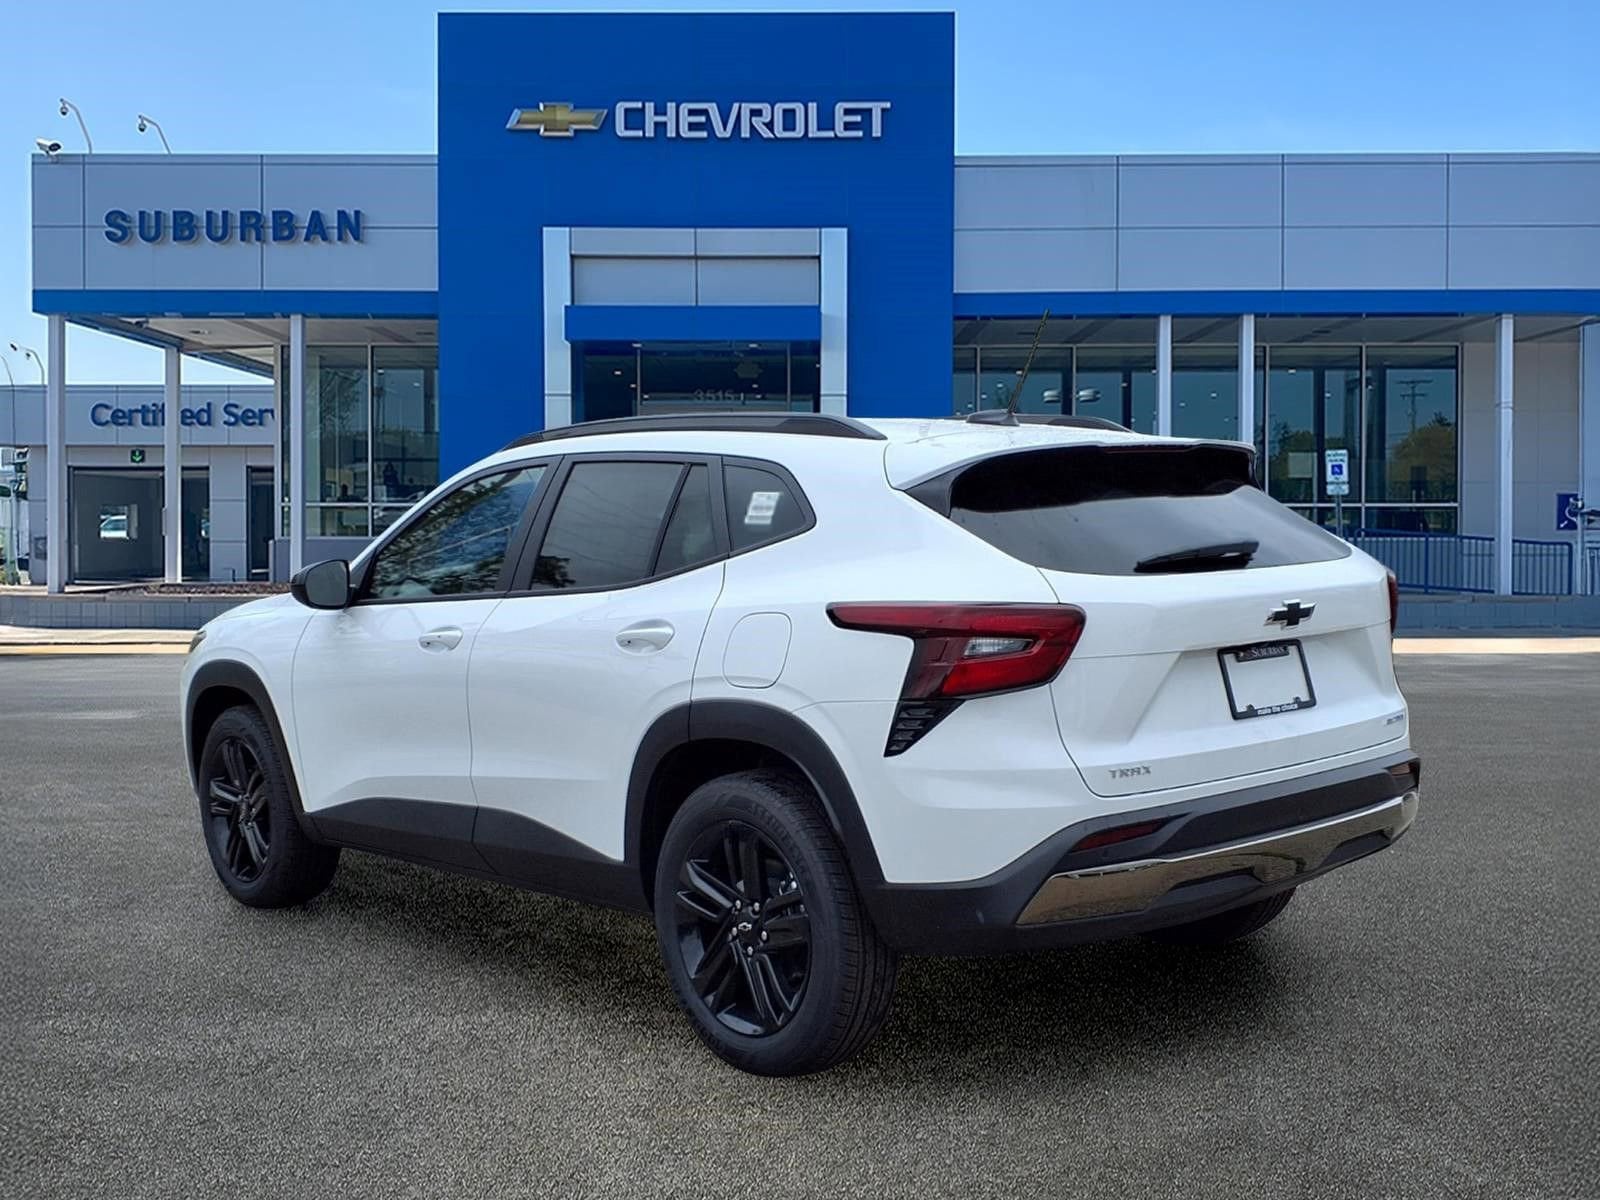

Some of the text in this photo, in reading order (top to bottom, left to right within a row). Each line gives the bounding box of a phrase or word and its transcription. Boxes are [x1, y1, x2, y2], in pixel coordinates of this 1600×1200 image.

[615, 101, 890, 139] CHEVROLET
[104, 209, 363, 244] SUBURBAN
[694, 389, 735, 402] 3515
[90, 402, 212, 426] Certifed
[1108, 766, 1152, 779] TRAX
